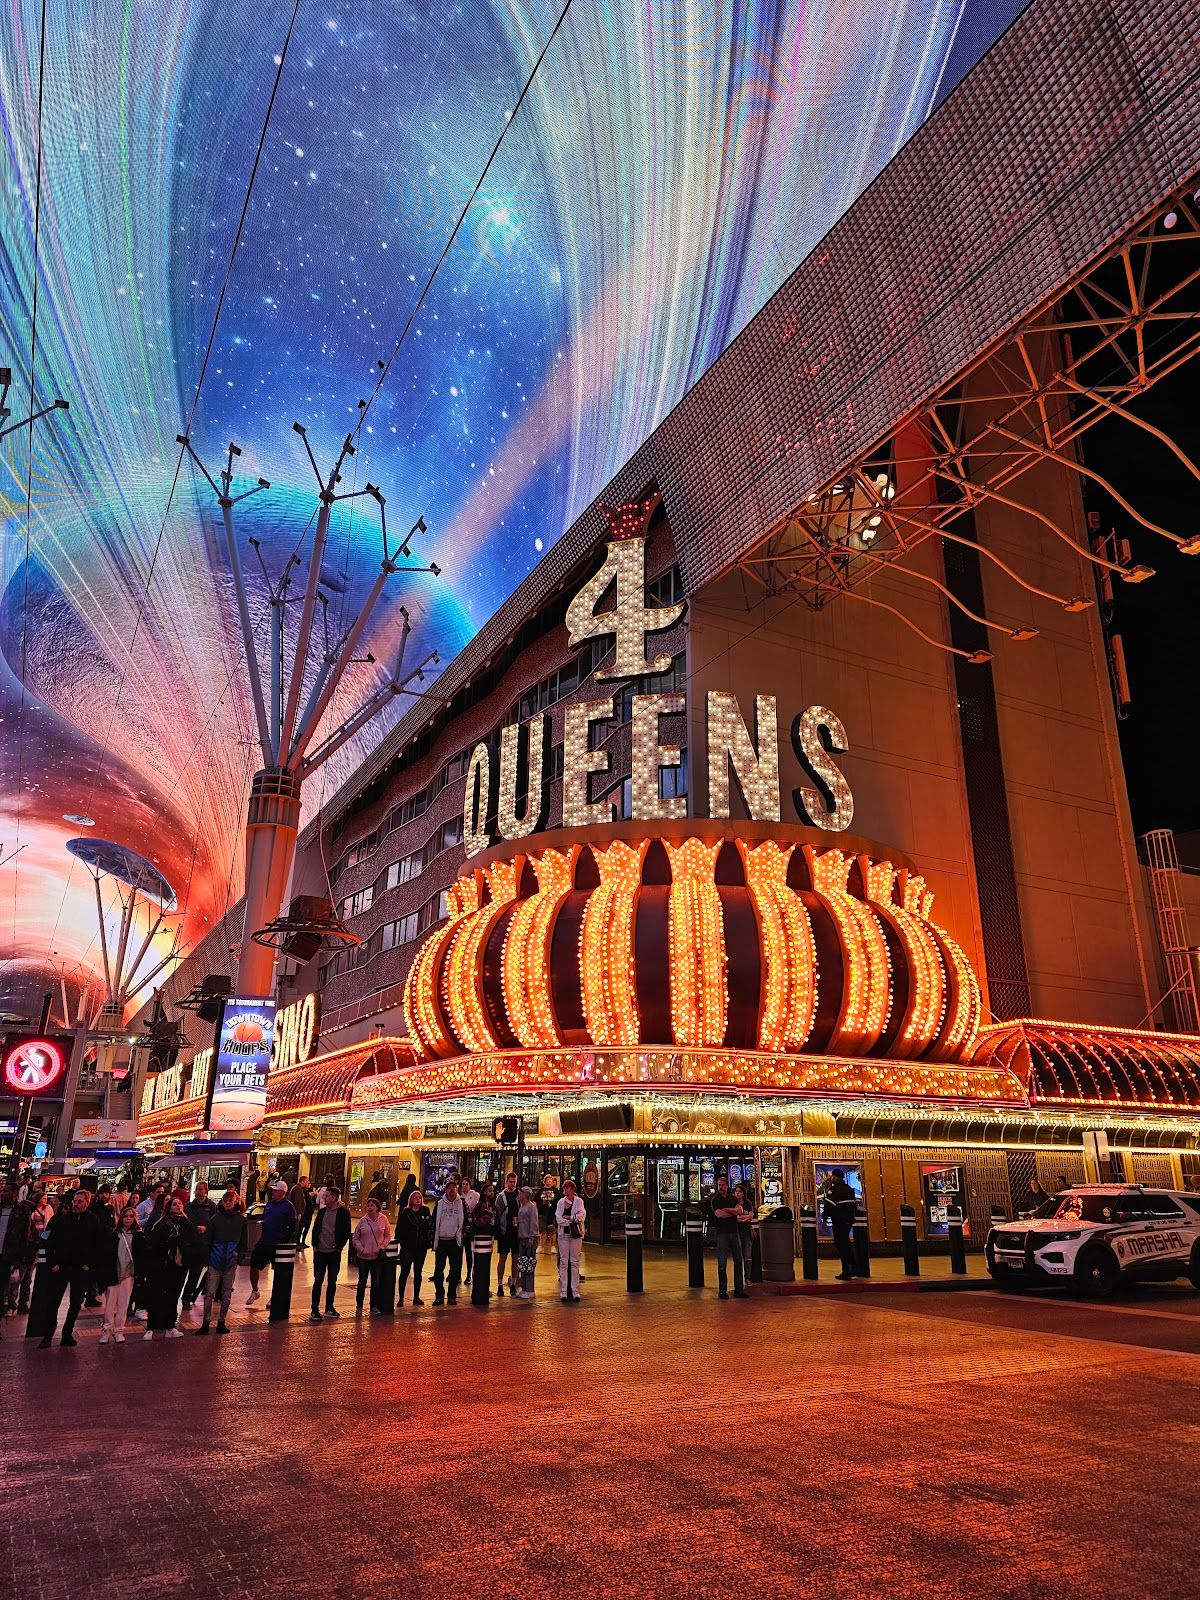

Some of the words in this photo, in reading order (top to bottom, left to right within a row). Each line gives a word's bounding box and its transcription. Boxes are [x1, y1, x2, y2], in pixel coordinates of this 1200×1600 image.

[565, 538, 687, 681] 4
[463, 691, 855, 860] QUEENS
[224, 1013, 274, 1030] DOWNTOWN
[221, 1038, 271, 1056] HOOPS
[230, 1061, 258, 1074] PLACE
[219, 1073, 243, 1086] YOUR
[244, 1074, 266, 1086] BETS
[1126, 1231, 1191, 1256] MARSHAL
